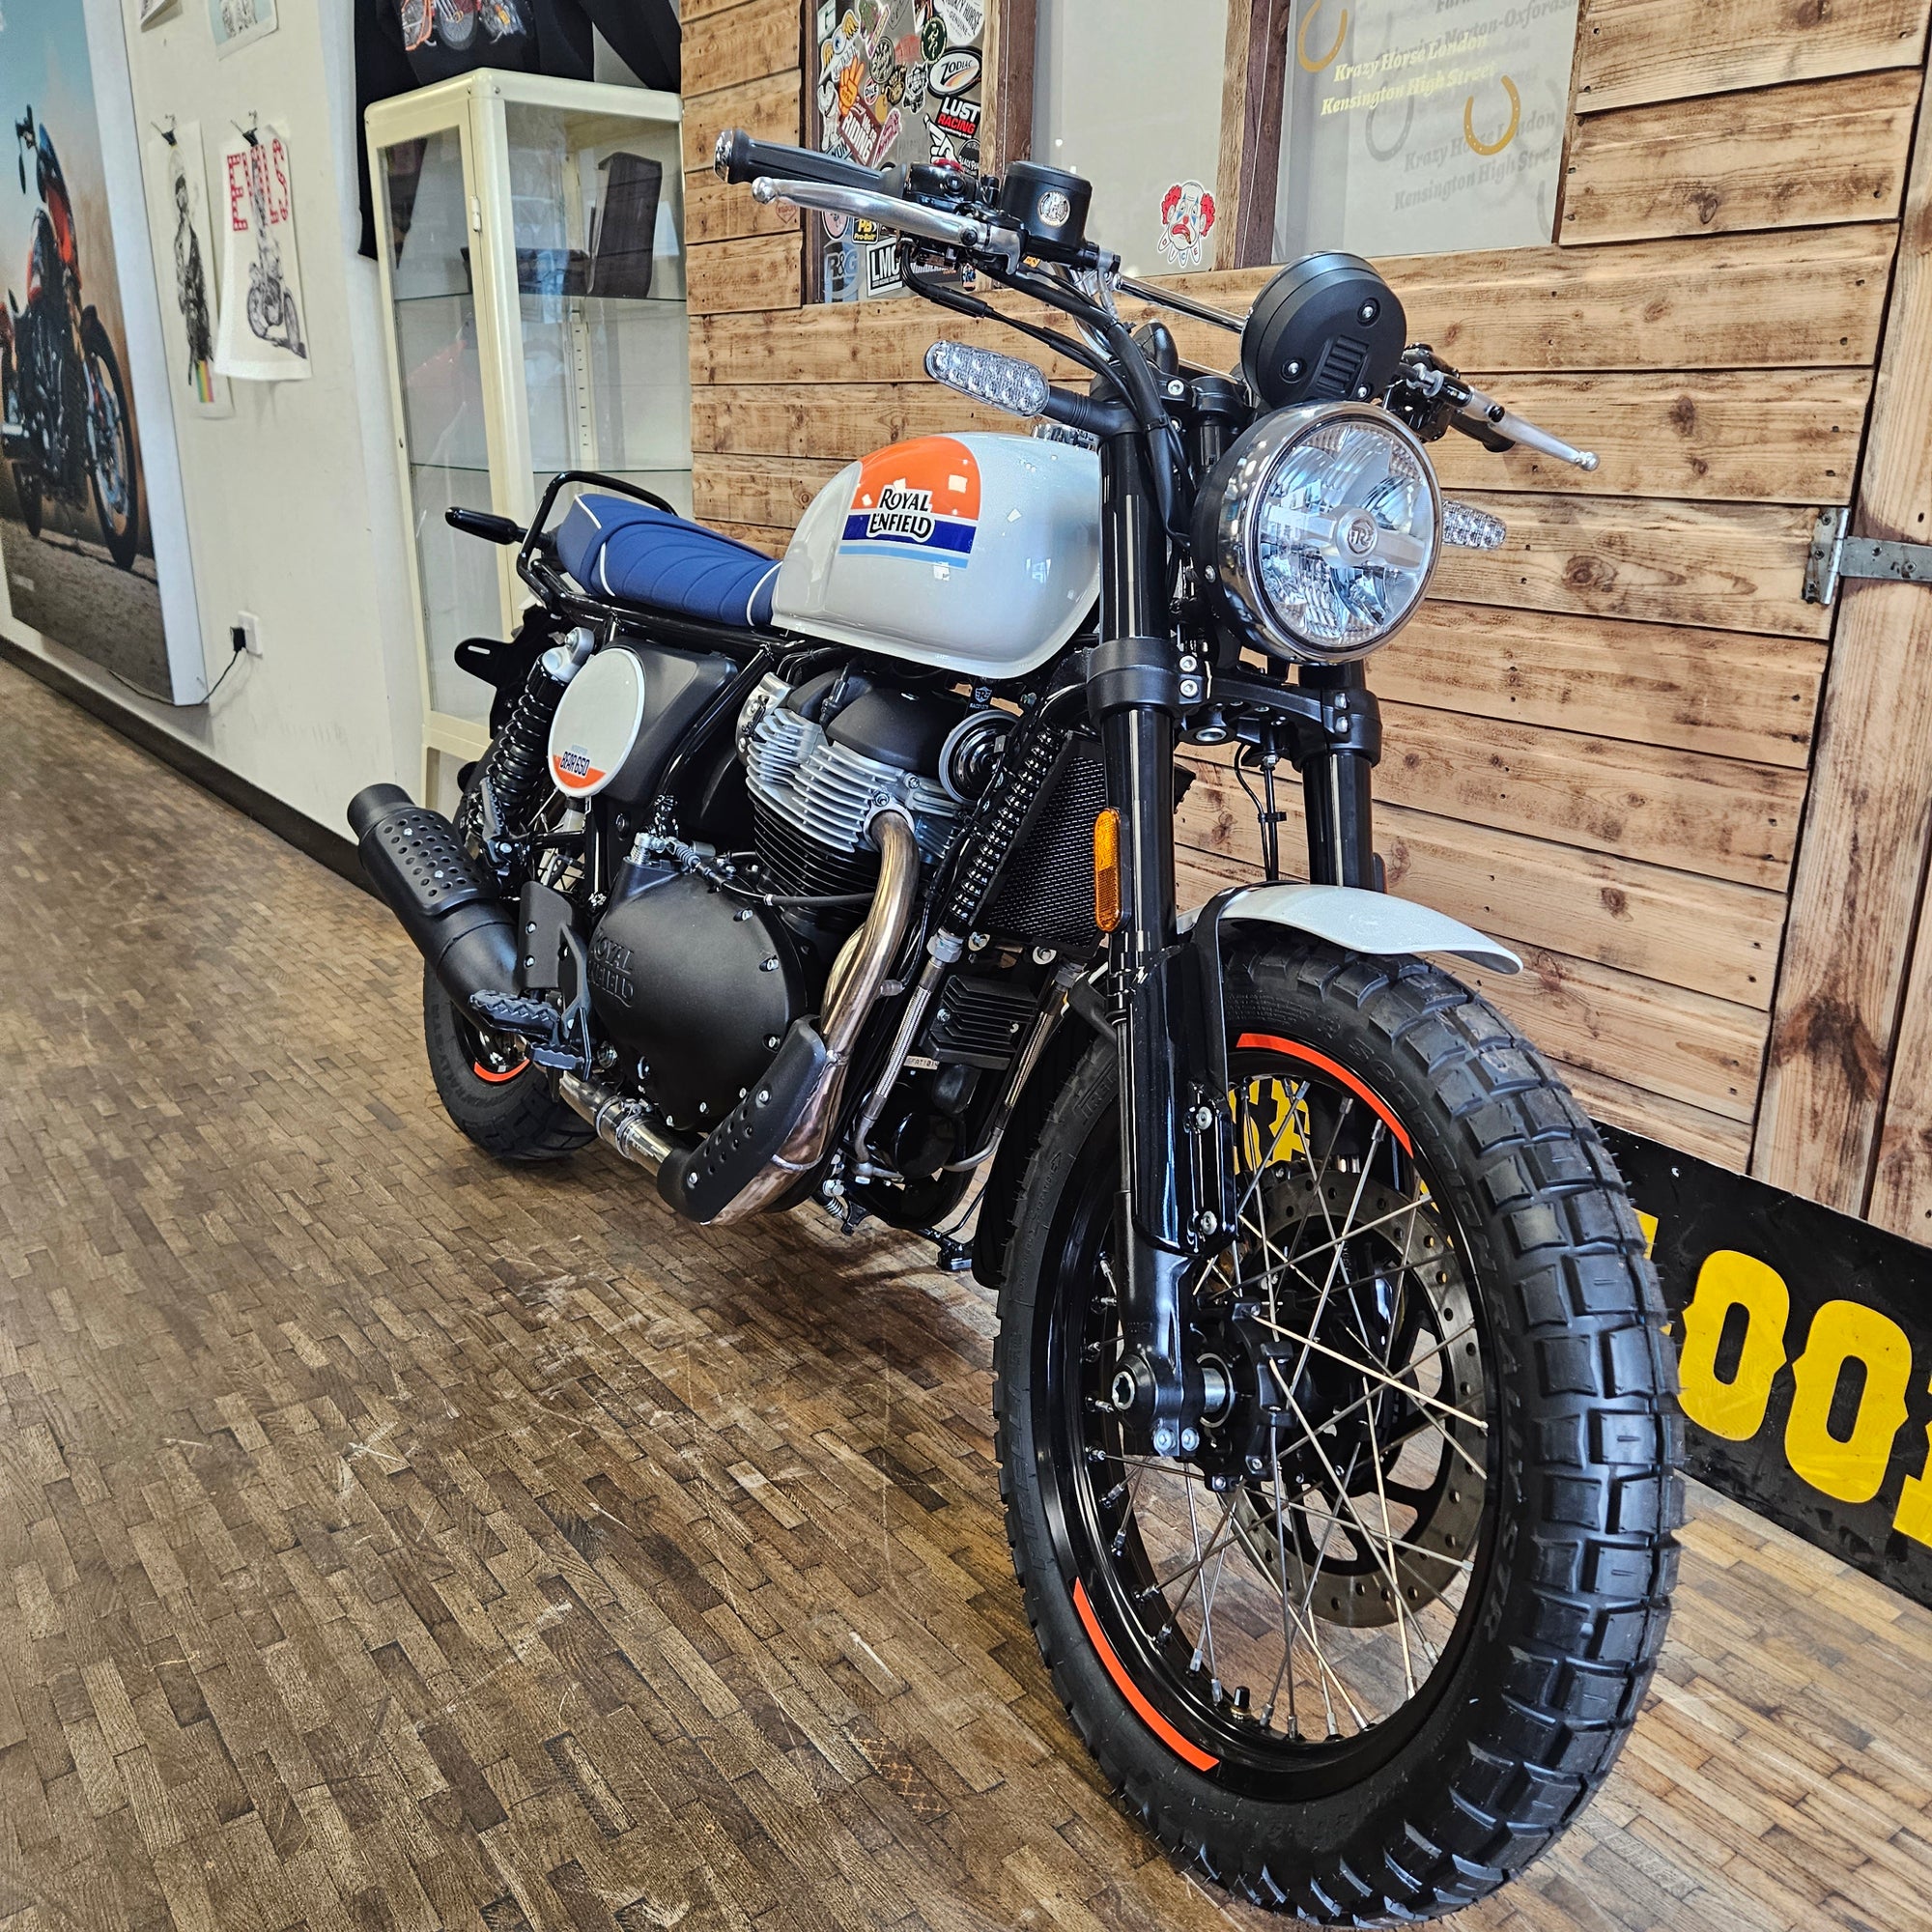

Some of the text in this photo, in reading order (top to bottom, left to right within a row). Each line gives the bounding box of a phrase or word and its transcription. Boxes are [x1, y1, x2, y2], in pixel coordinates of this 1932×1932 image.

[950, 11, 968, 36] GENUINE
[1334, 60, 1378, 82] Krazy
[1379, 50, 1425, 72] Horse
[1427, 32, 1488, 60] London
[940, 60, 973, 86] ZODIAC
[1321, 60, 1496, 116] Kensington High Street
[941, 97, 981, 123] LUST
[841, 110, 873, 163] RIDING
[938, 113, 976, 134] RACING
[827, 249, 860, 279] R&G
[870, 244, 900, 282] LMC
[879, 488, 929, 512] ROYAL
[869, 513, 932, 539] ENFIELD
[560, 751, 590, 777] BEAR 650
